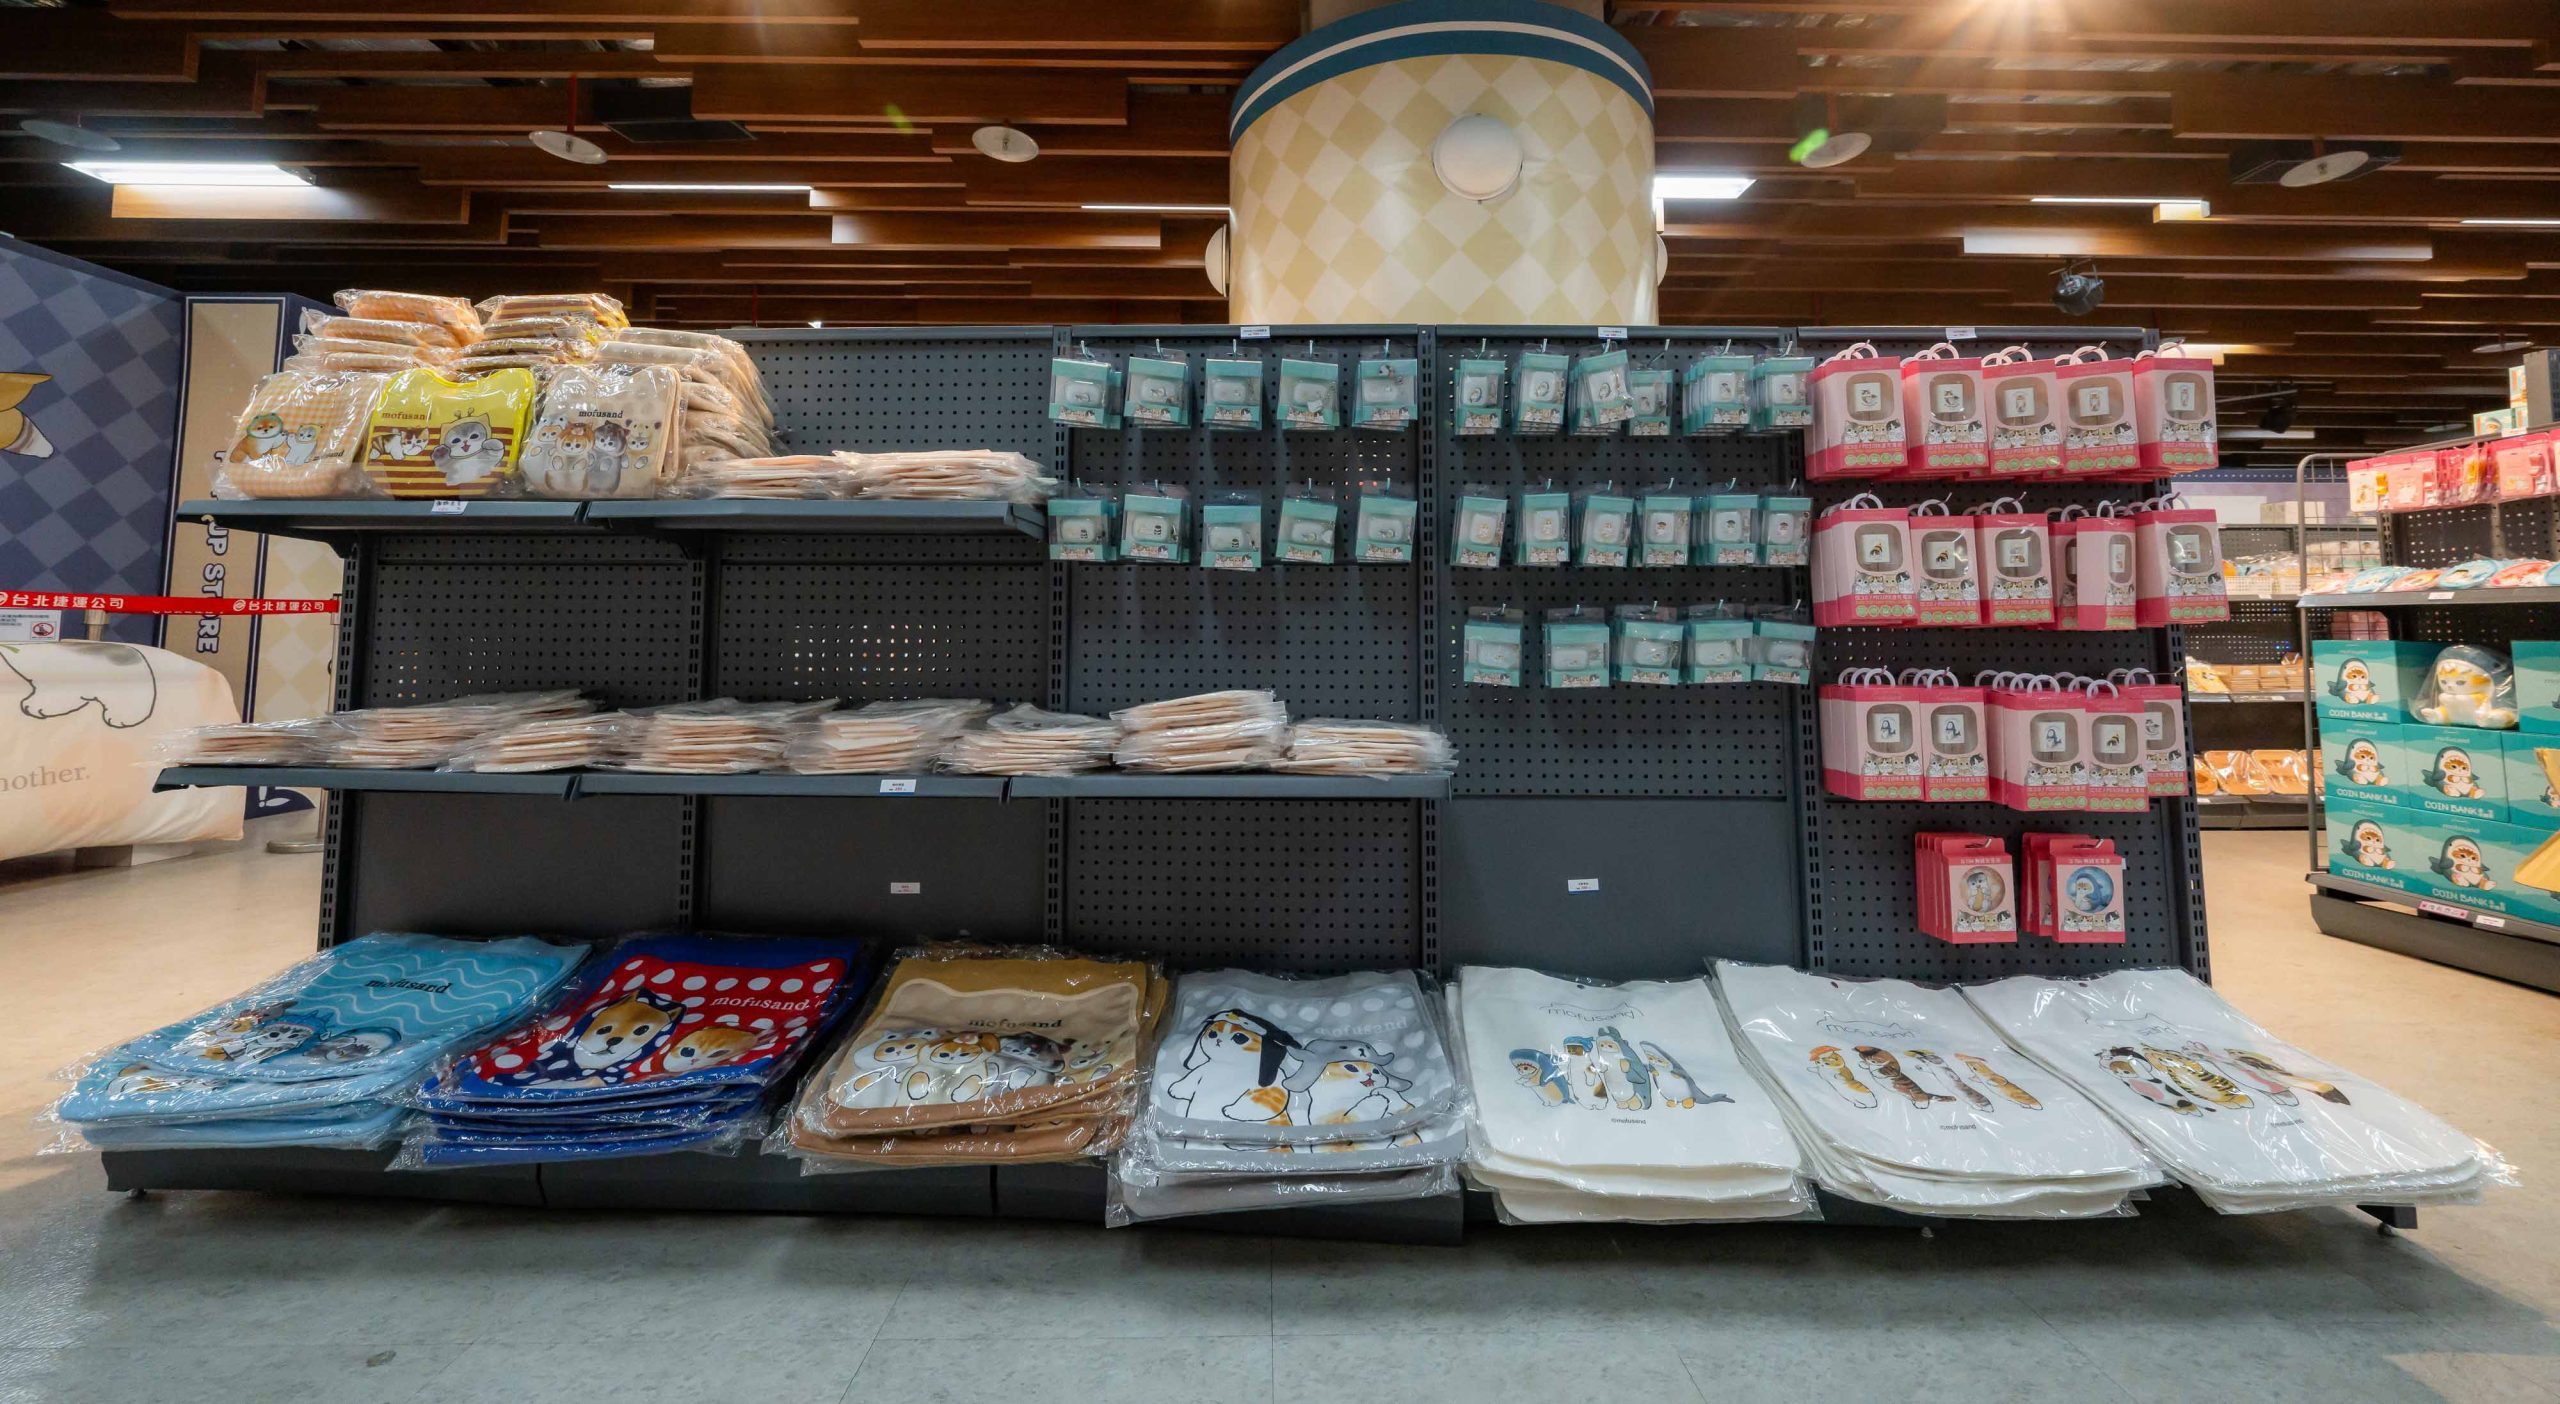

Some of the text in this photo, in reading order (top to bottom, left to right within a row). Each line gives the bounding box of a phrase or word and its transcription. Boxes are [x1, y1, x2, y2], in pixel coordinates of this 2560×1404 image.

[578, 409, 624, 419] mofusand
[12, 594, 124, 609] 台北捷運公司
[196, 563, 226, 653] STRE
[248, 600, 325, 611] 台北捷運公司
[2328, 709, 2350, 717] COIN
[2336, 788, 2384, 801] COIN BANK
[2424, 801, 2478, 815] COIN BANK
[2341, 868, 2390, 884] COIN BANK
[2431, 888, 2489, 906] COIN BANK
[365, 978, 453, 994] mofusand
[710, 996, 810, 1011] mofusand
[968, 1018, 1063, 1028] mofusand
